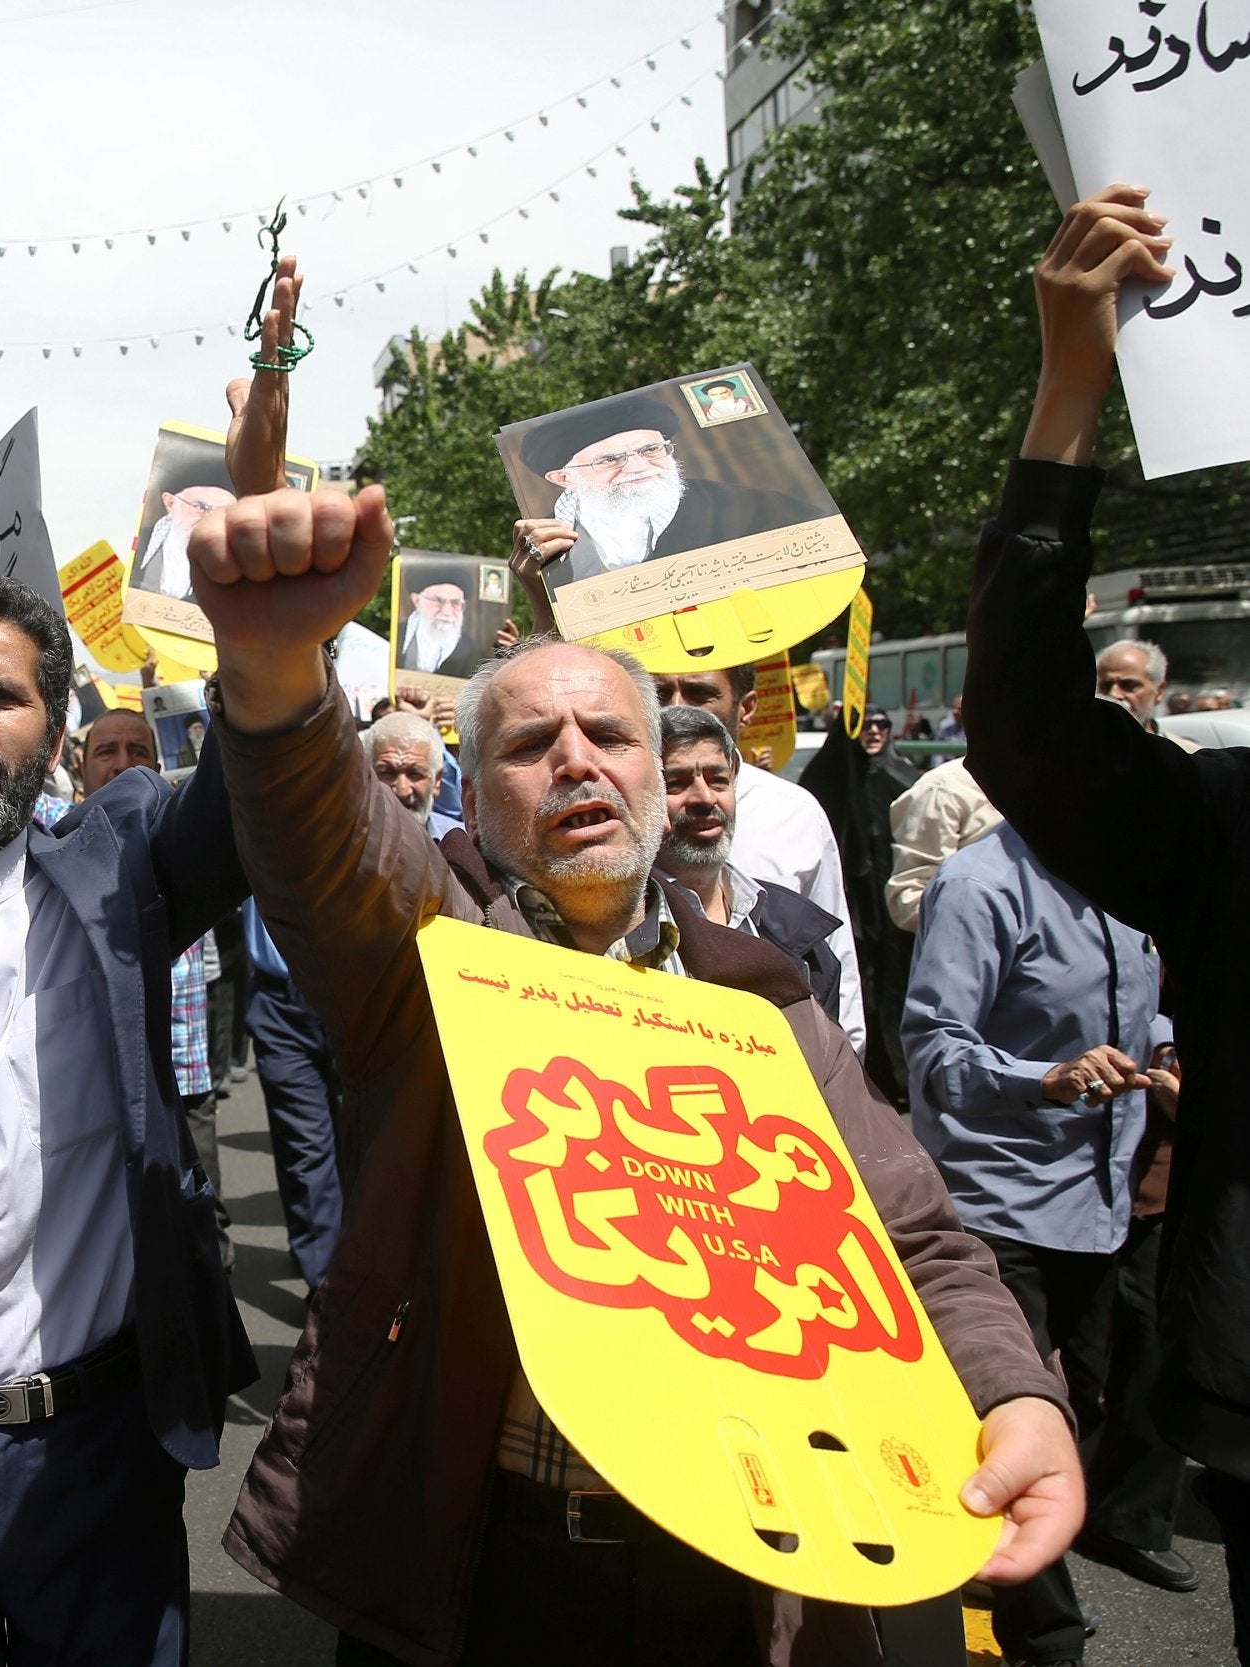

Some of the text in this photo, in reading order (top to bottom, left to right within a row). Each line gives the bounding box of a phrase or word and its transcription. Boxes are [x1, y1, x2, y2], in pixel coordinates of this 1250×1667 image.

[731, 552, 747, 571] فقیه
[791, 532, 830, 557] پشتیبان
[457, 968, 777, 1056] مبارزه با استکبار تعطیل پذیر نیست
[508, 1075, 832, 1212] مرگ بر
[621, 1156, 716, 1194] DOWN
[656, 1192, 736, 1228] WITH
[701, 1231, 783, 1269] U.S.A
